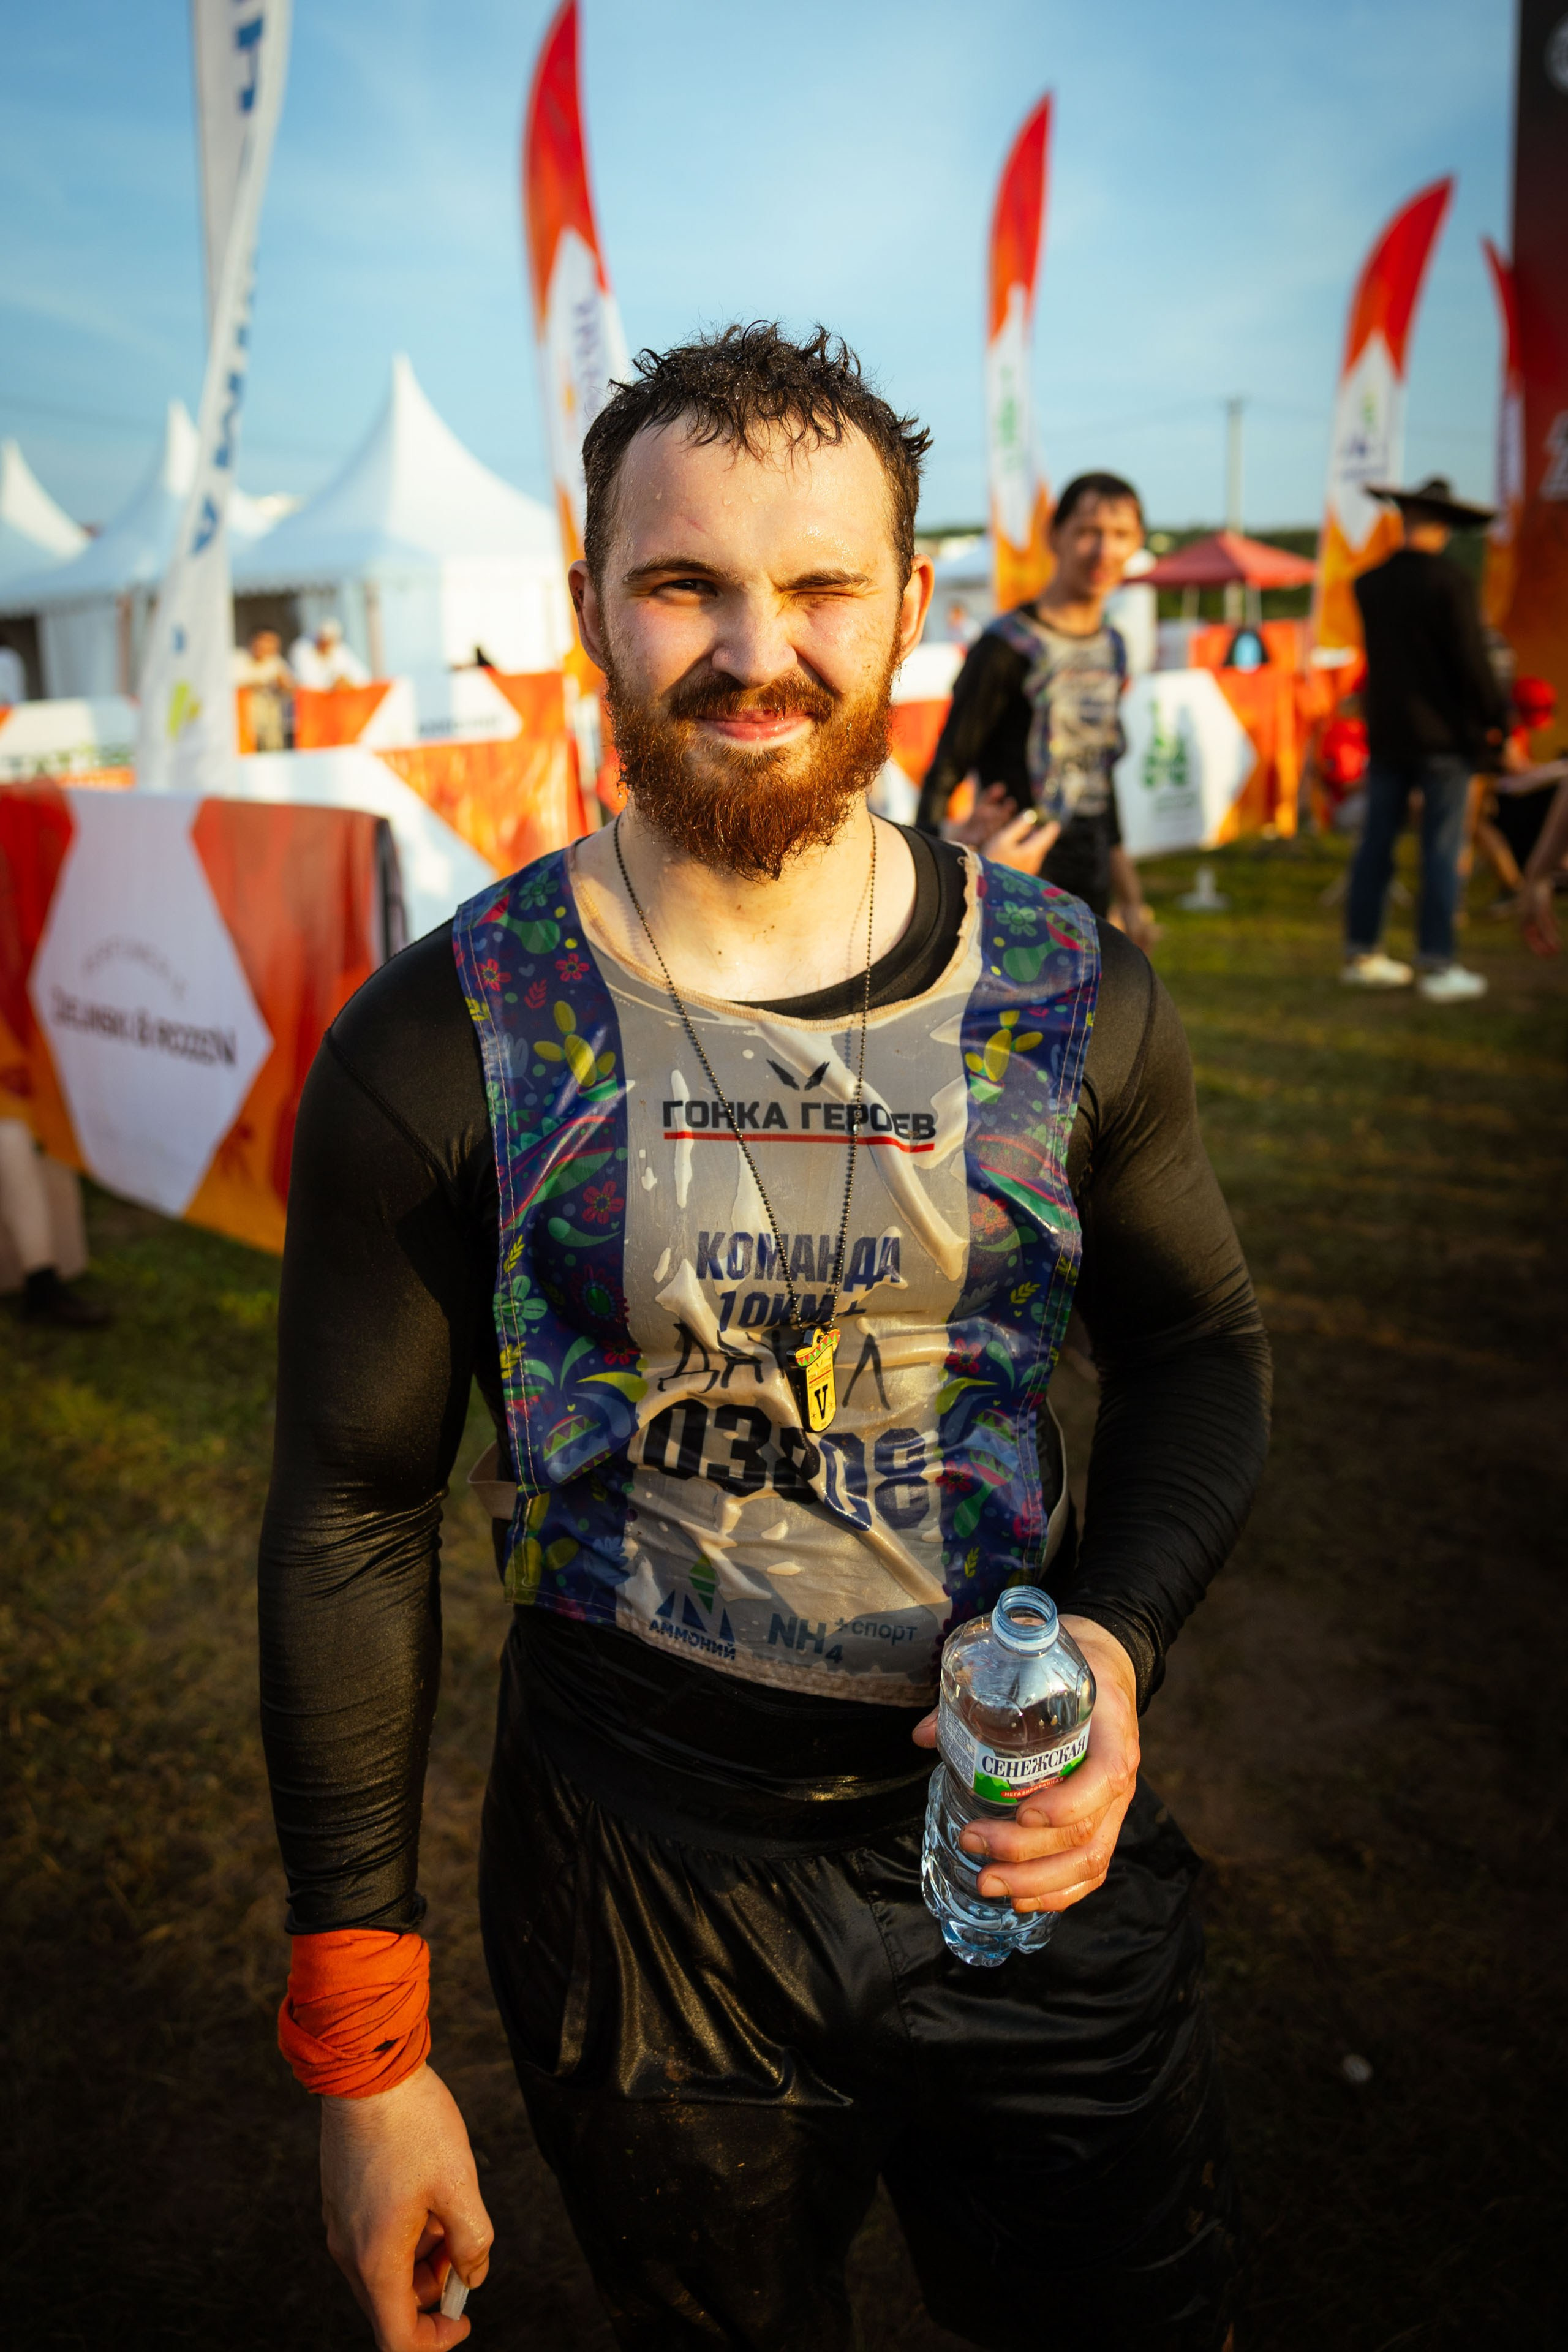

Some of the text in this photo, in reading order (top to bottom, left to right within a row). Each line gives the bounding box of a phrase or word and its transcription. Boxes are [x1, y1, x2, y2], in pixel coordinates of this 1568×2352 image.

[662, 1101, 937, 1139] ГОНКА ГЕРОЕВ
[696, 1231, 900, 1292] КОМАНДА
[815, 1384, 828, 1420] V
[649, 1619, 736, 1661] АММОНИЙ
[982, 1735, 1085, 1777] СЕНЕЖСКАЯ
[1005, 1777, 1064, 1797] НЕГАЗИРОВАННАЯ
